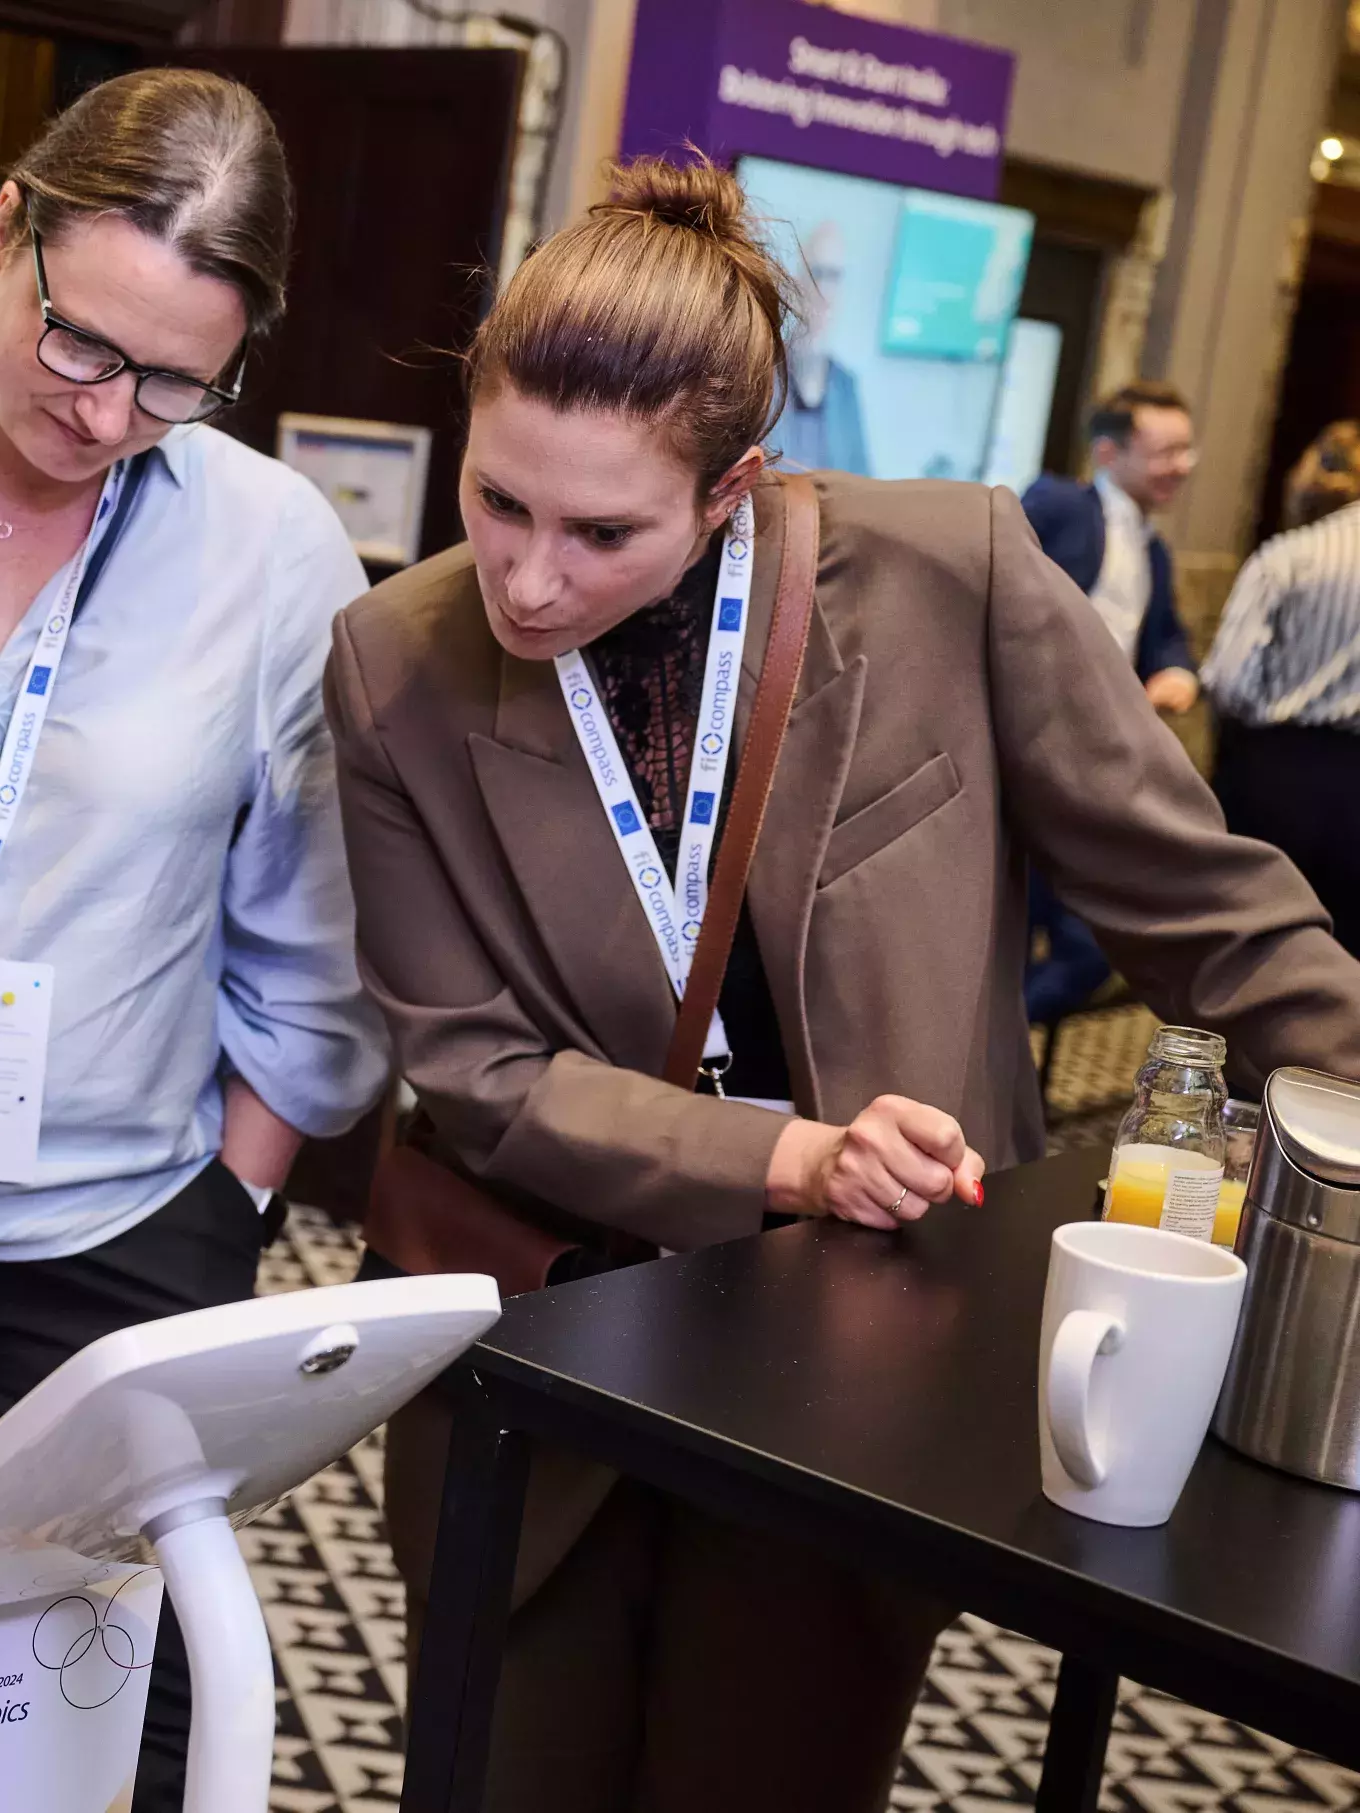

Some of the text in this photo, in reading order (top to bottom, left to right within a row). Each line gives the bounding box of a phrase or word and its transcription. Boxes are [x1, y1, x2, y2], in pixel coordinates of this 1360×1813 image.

[710, 650, 733, 730] compass
[8, 711, 37, 783] compass
[580, 712, 618, 787] compass
[684, 843, 703, 918] compass
[648, 890, 680, 963] compass
